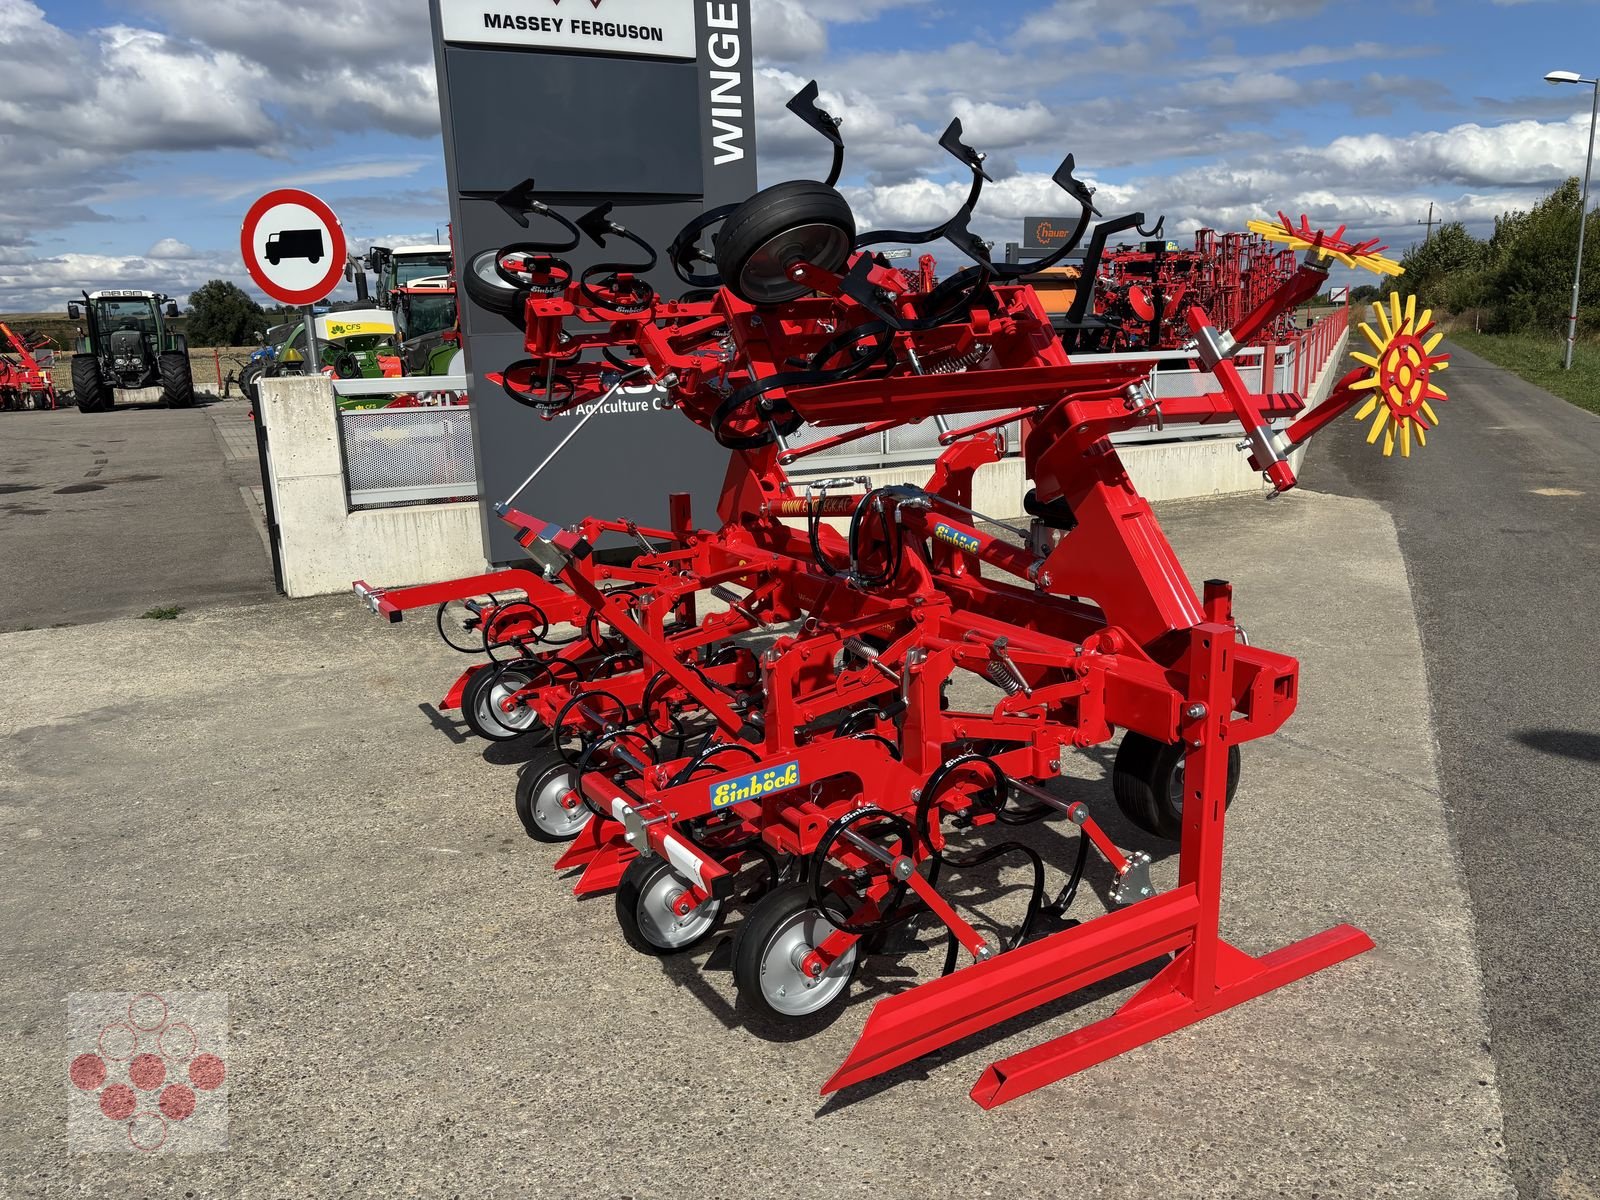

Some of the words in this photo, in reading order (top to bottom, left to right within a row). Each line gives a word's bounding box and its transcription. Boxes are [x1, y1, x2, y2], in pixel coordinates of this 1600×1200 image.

[484, 13, 564, 33] MASSEY
[571, 19, 663, 42] FERGUSON
[706, 1, 744, 166] WINGE
[1041, 223, 1069, 238] hauer
[345, 323, 361, 331] CFS
[935, 525, 978, 553] Einböck
[713, 764, 798, 806] Einböck
